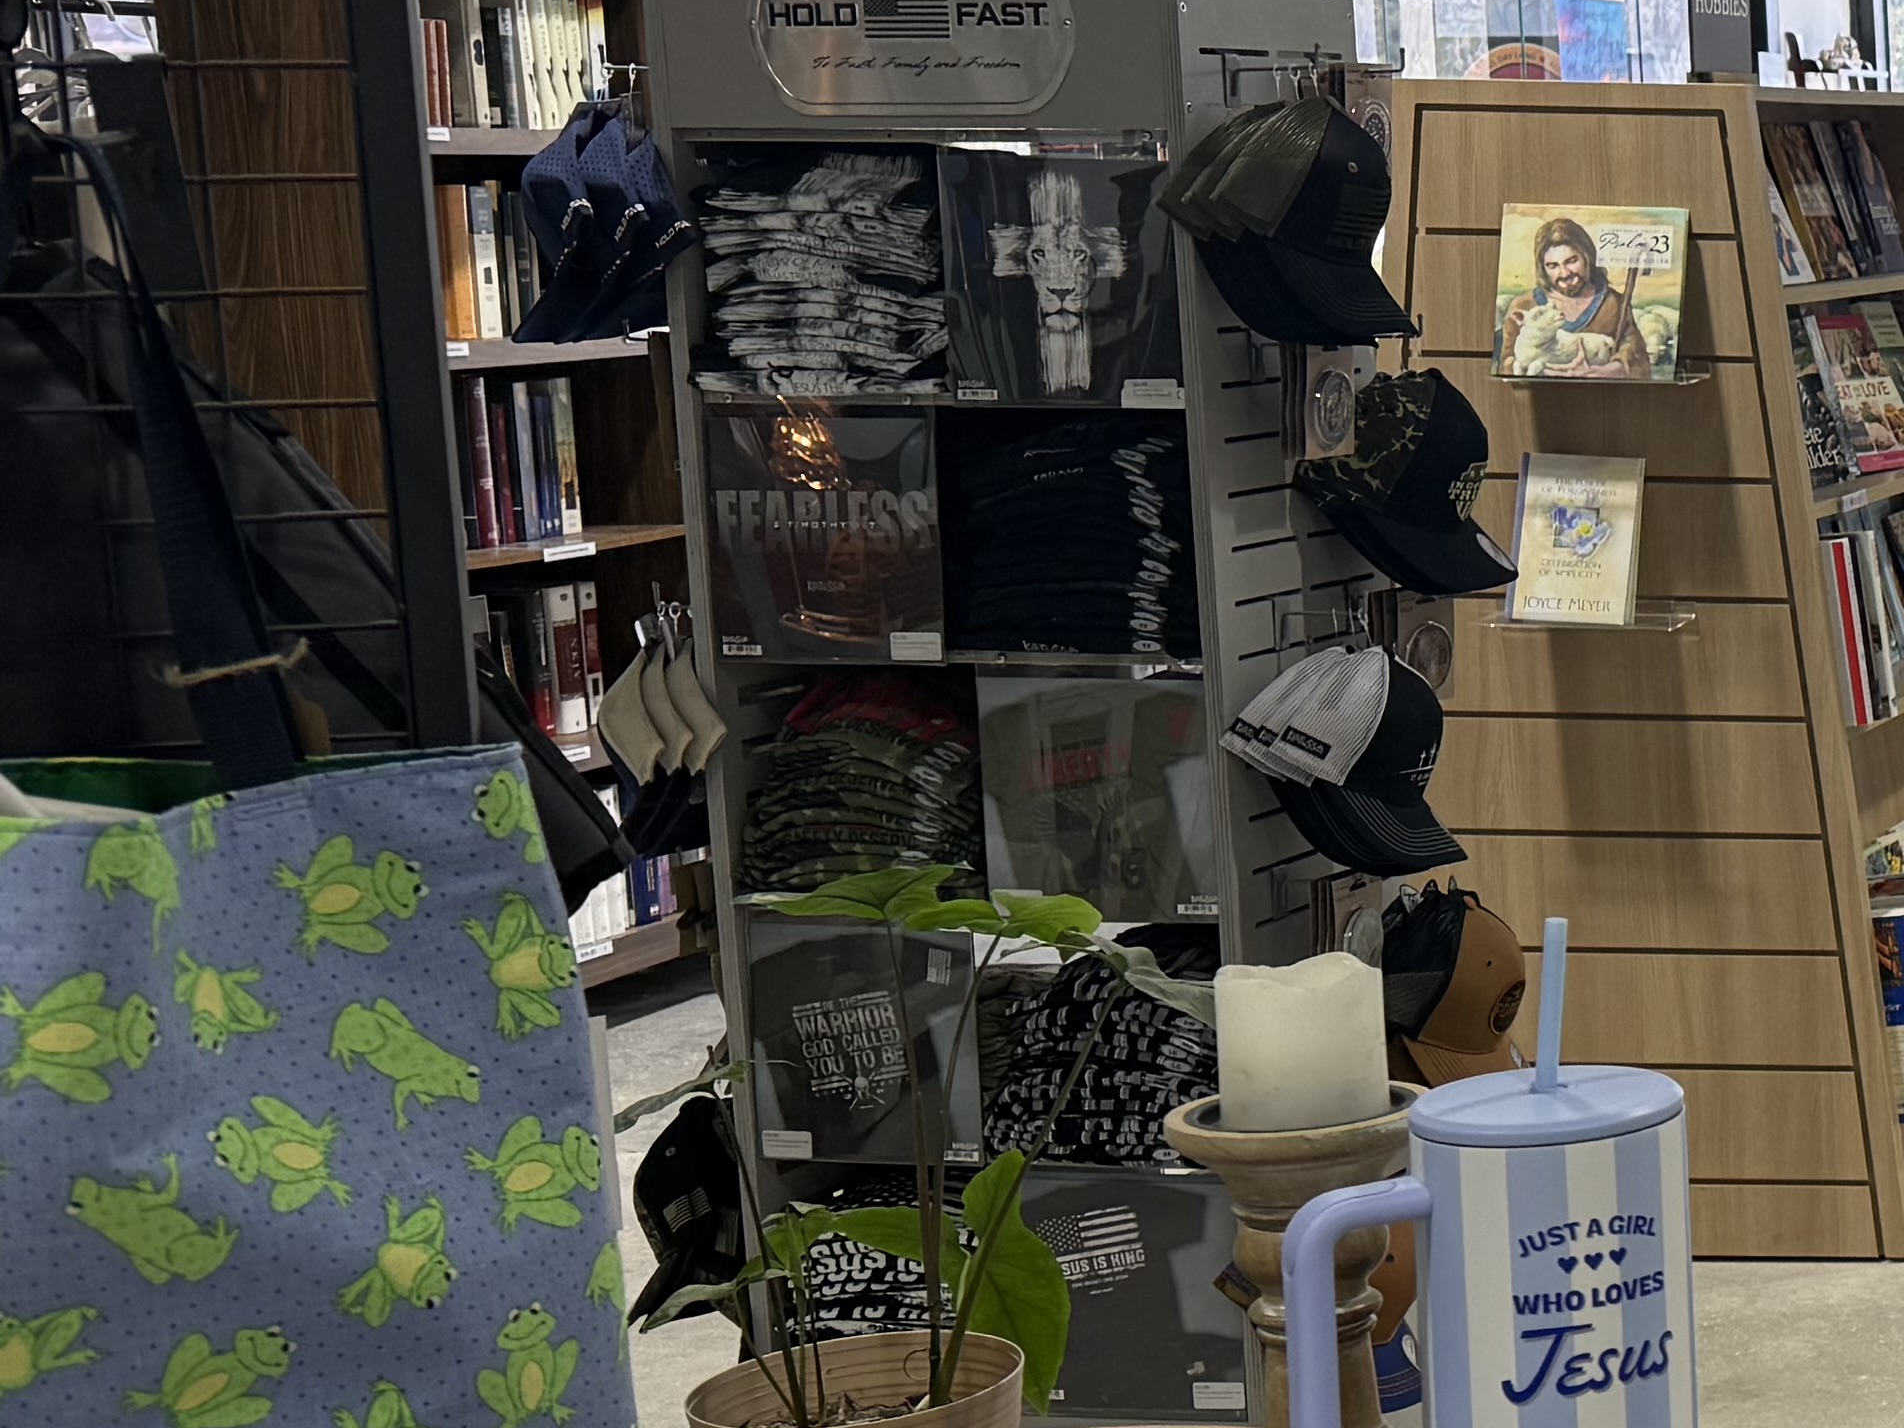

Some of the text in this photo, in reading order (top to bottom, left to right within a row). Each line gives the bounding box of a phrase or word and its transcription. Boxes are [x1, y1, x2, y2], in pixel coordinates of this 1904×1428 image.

[767, 2, 1049, 27] HOLD FAST
[1648, 234, 1669, 254] 23
[716, 489, 938, 553] FEARLESS
[788, 521, 848, 530] TIMOTHY
[1522, 595, 1612, 613] JOYCE MEYER
[795, 1002, 897, 1043] WARRIOR
[802, 1025, 901, 1060] GOD CALLED
[805, 1048, 877, 1079] YOU TO
[1516, 1214, 1659, 1259] JUST A GIRL
[1094, 1245, 1146, 1272] IS KING
[1513, 1269, 1666, 1316] WHO LOVES
